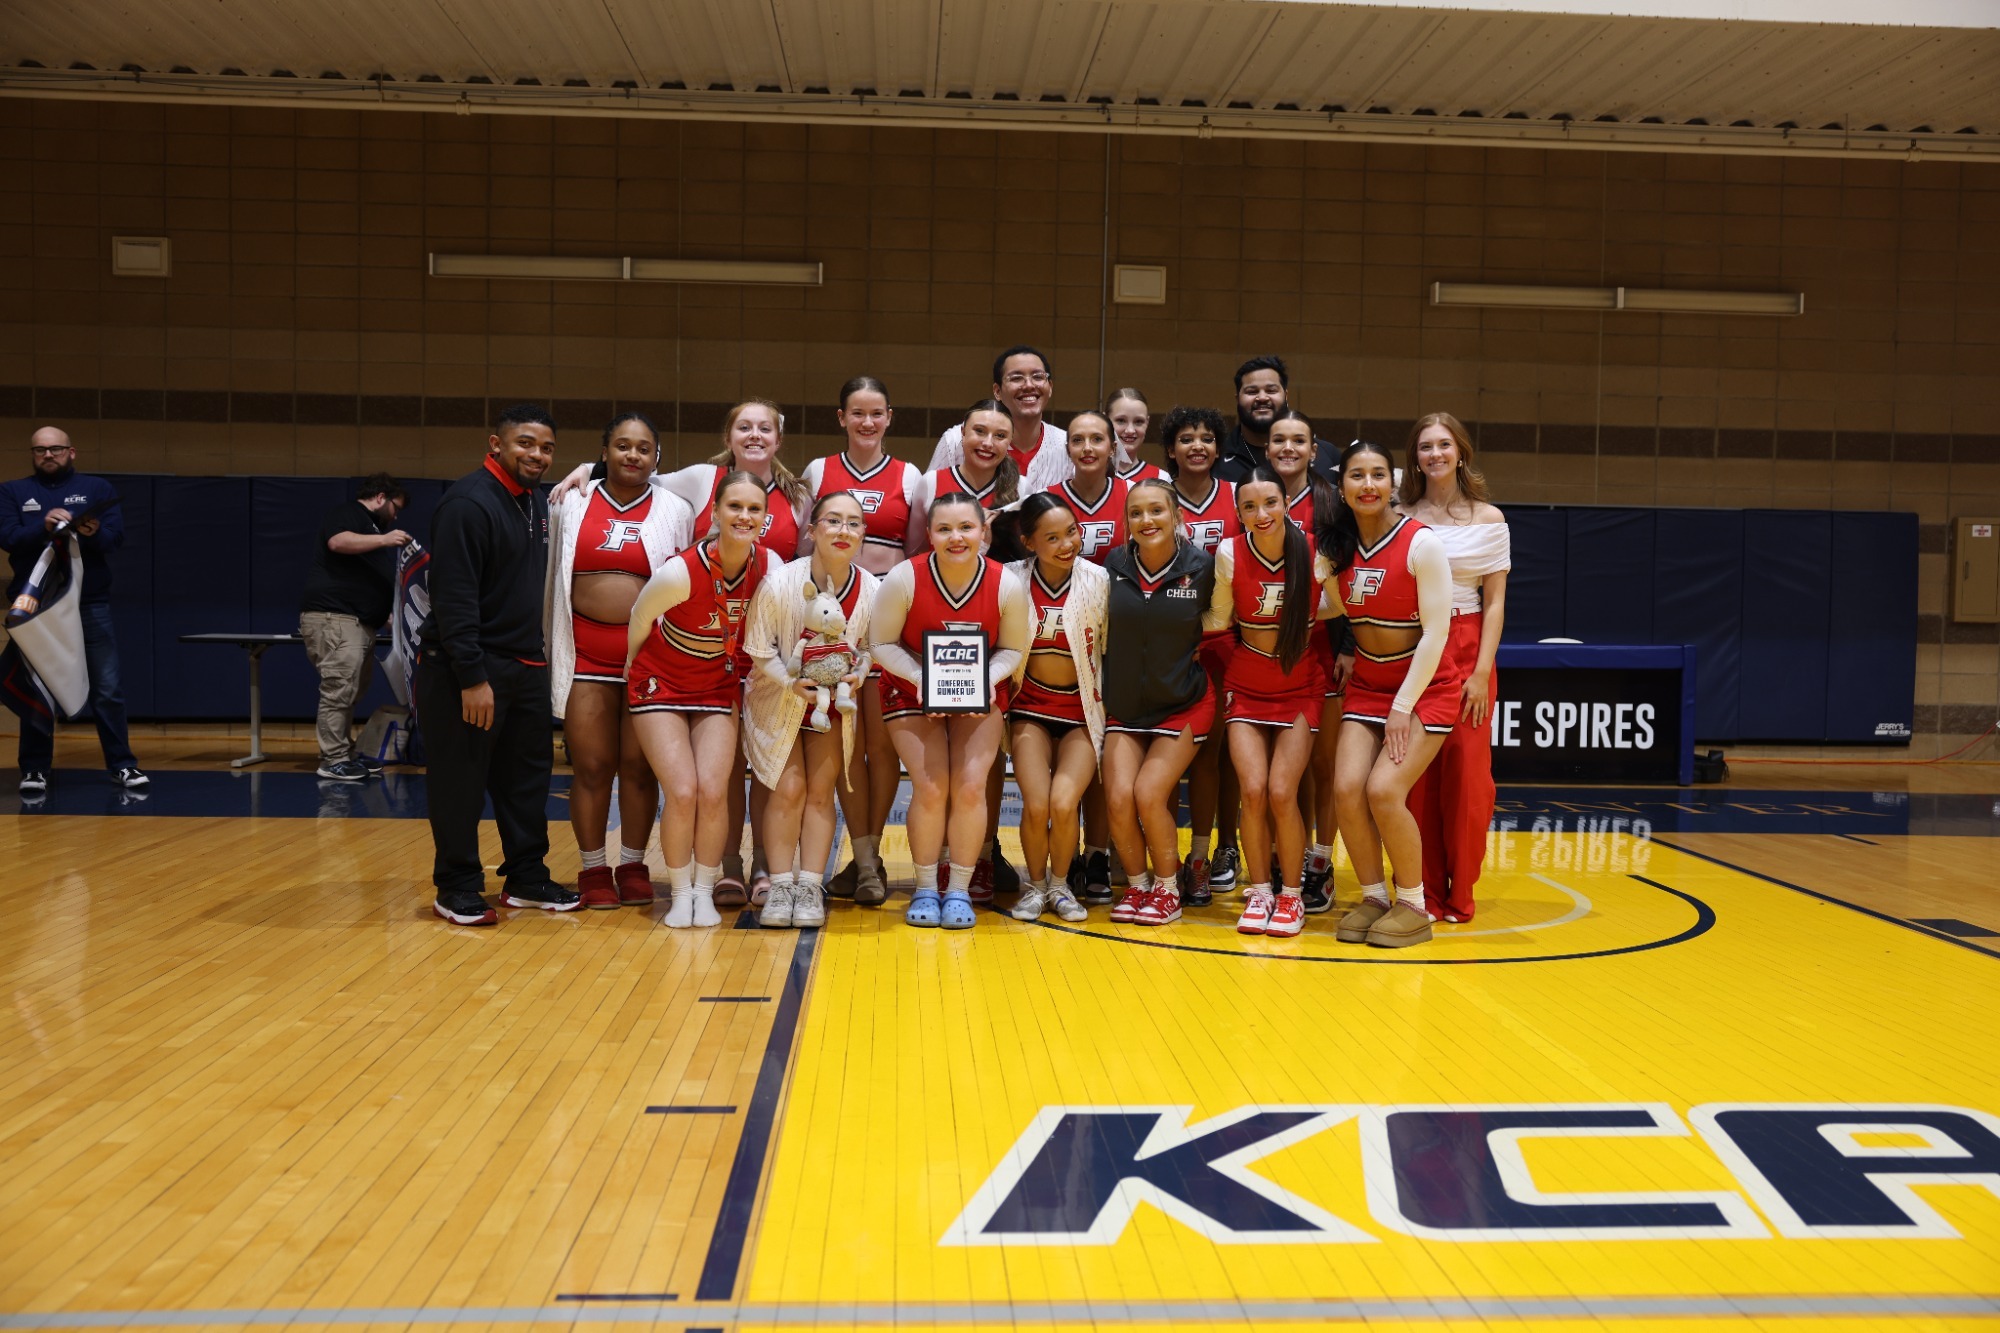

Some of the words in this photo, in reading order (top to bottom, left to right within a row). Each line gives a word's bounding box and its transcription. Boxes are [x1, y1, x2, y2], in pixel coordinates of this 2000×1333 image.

[595, 519, 643, 551] F
[1079, 520, 1115, 556] F
[1166, 588, 1198, 599] CHEER
[1346, 567, 1387, 605] F
[935, 648, 977, 660] KCAC
[937, 688, 965, 696] RUNNER
[966, 688, 976, 696] UP
[1534, 701, 1656, 750] SPIRES
